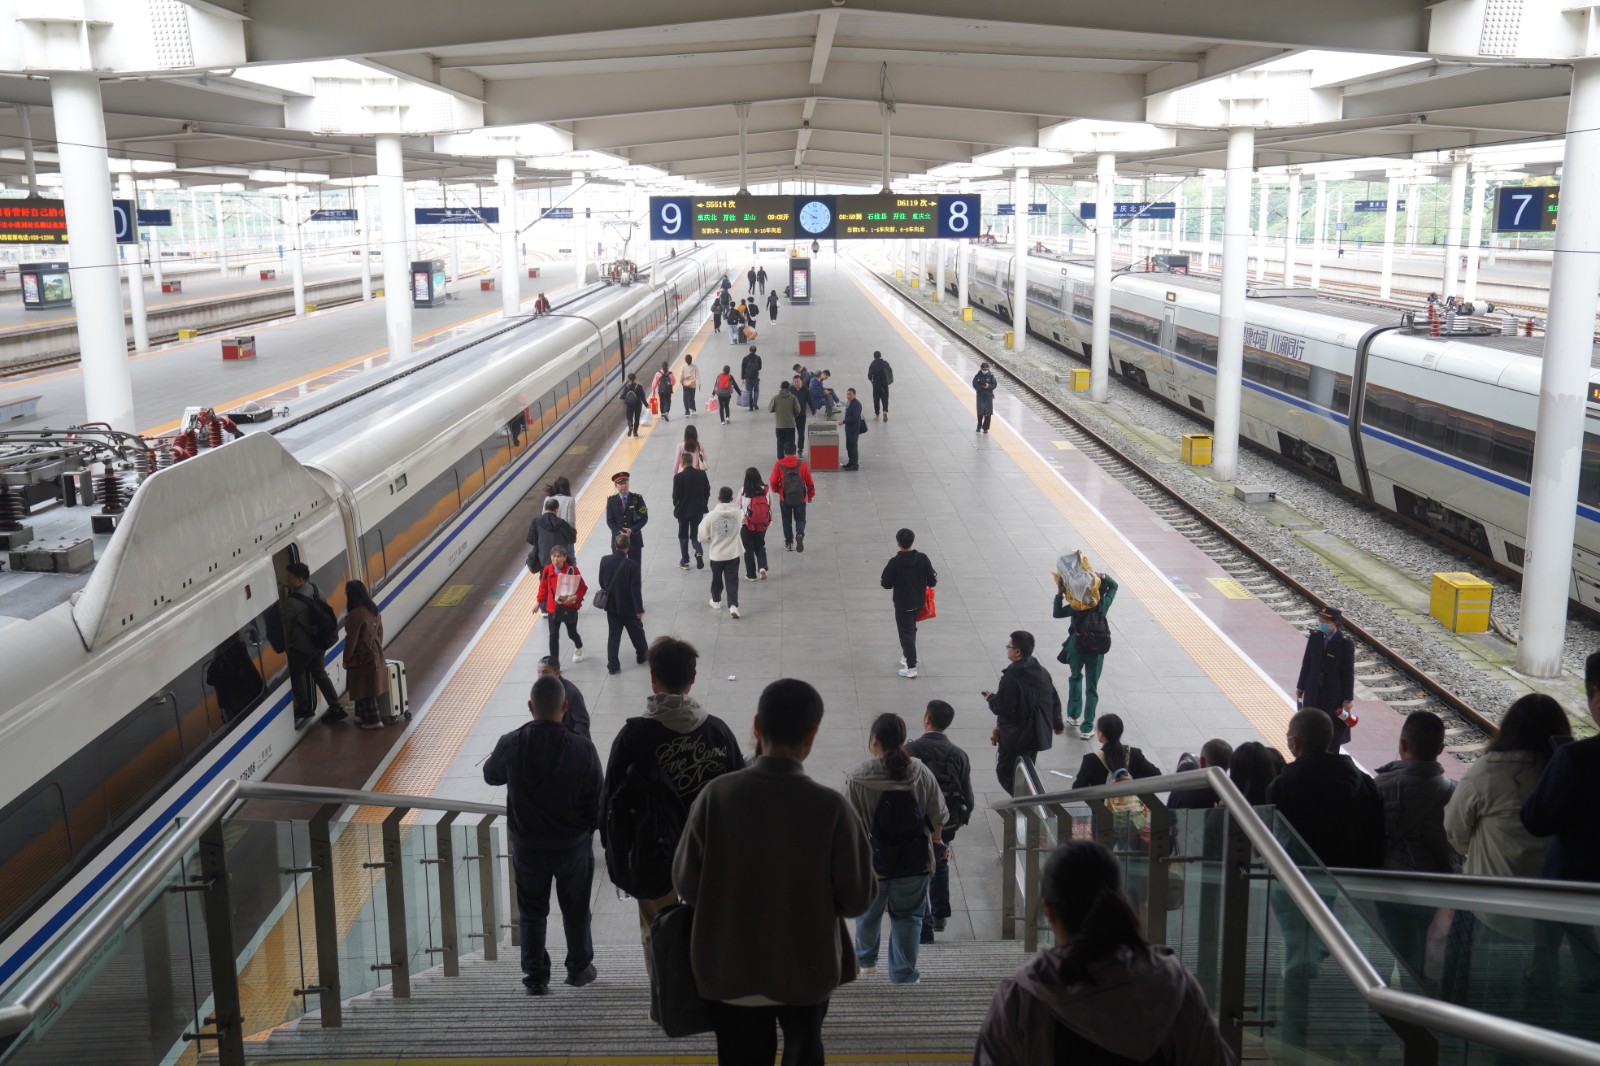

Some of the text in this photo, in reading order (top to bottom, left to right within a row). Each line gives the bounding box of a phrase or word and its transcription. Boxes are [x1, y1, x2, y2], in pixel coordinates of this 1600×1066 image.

[0, 207, 65, 217] 看管好自己的小
[896, 199, 918, 207] D6119
[947, 200, 969, 233] 8
[1511, 194, 1533, 226] 7
[660, 202, 682, 235] 9
[1271, 333, 1306, 361] 川渝同行
[693, 742, 728, 763] Come
